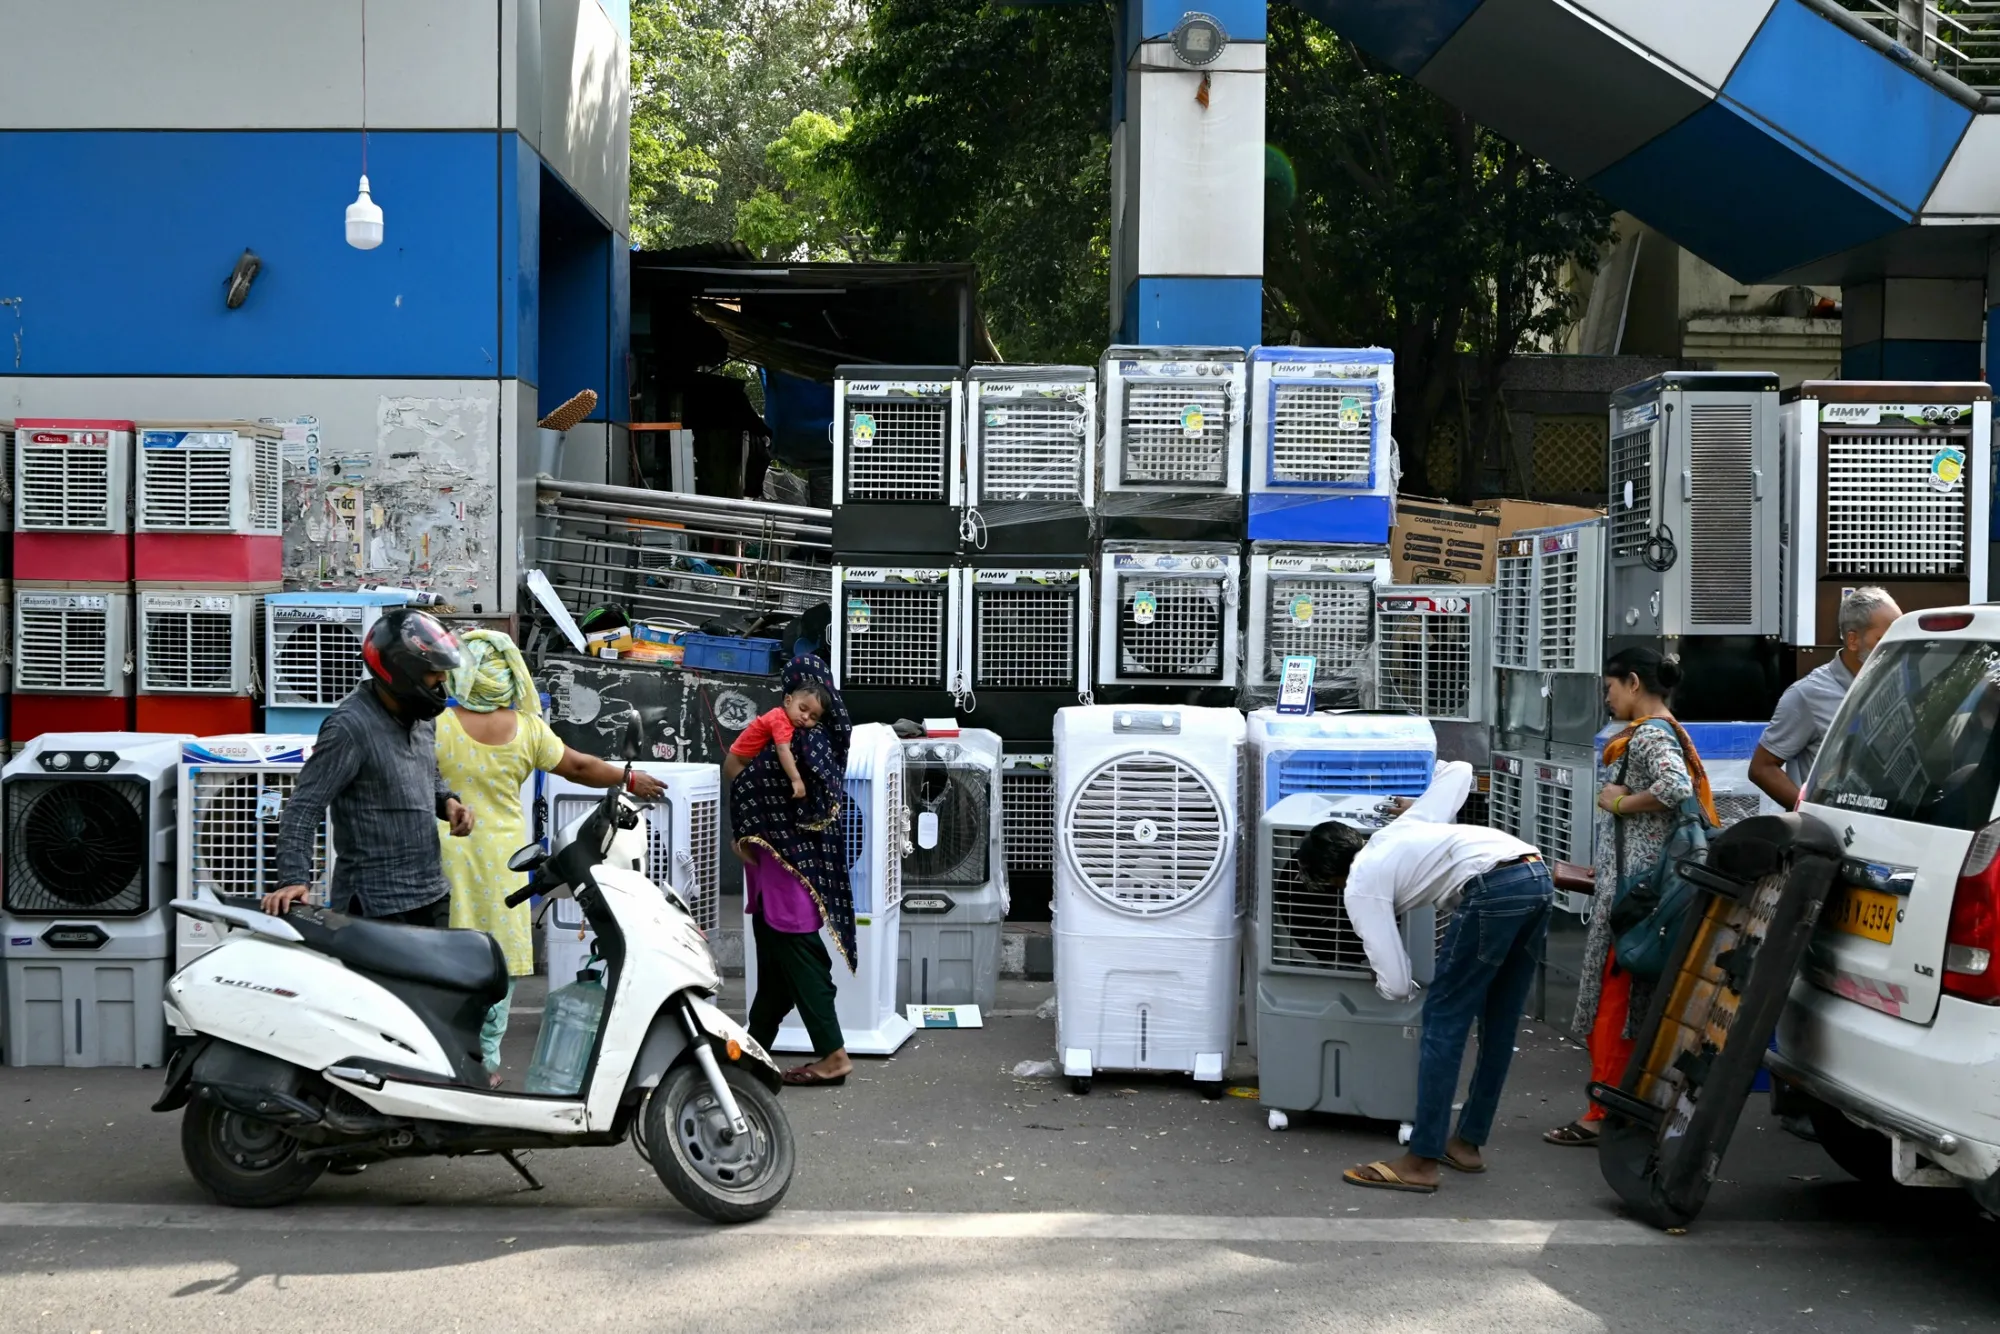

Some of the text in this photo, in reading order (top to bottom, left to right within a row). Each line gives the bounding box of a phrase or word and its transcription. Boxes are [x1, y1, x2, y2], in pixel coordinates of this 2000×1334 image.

[986, 384, 1014, 392] HMW
[1829, 407, 1870, 416] HMW
[1414, 516, 1477, 529] COMMERCIAL COOLER
[655, 745, 672, 757] 798
[1863, 902, 1893, 933] 4394
